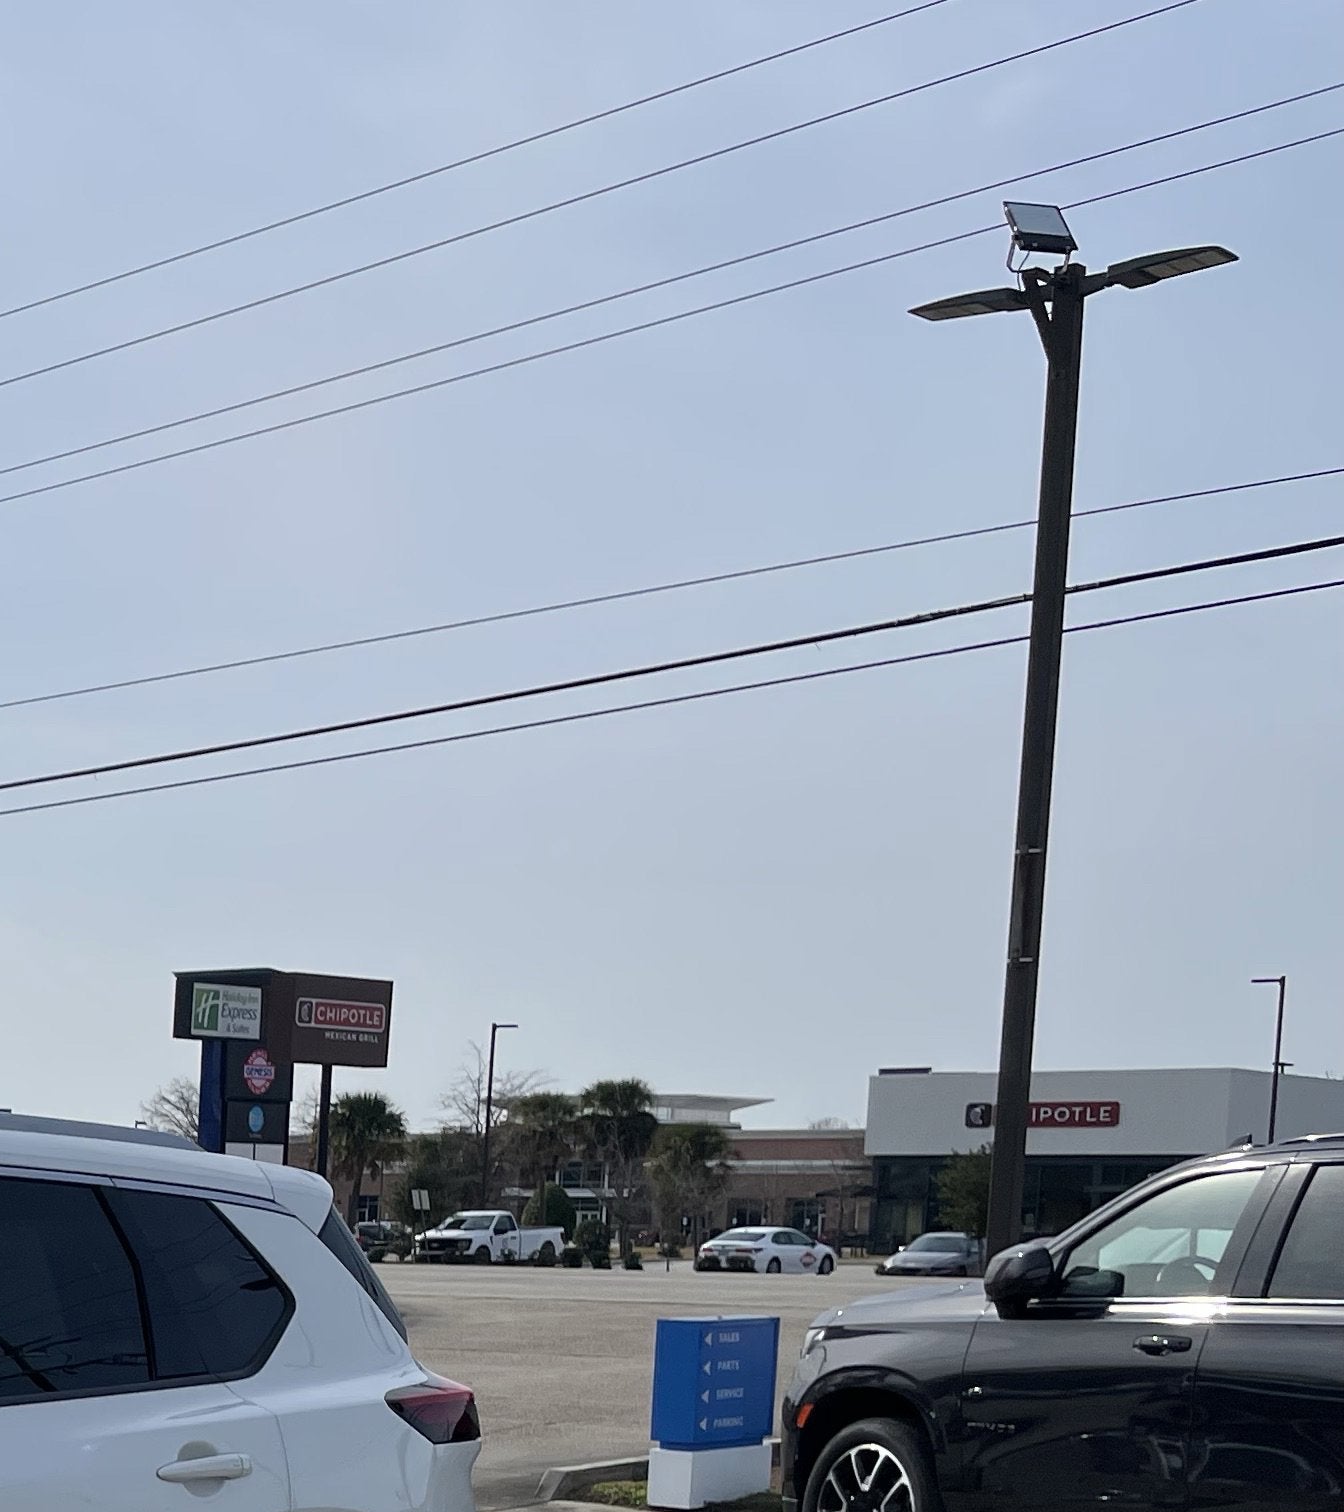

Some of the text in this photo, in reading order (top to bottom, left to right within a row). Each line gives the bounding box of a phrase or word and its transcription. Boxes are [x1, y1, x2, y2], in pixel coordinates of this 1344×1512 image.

[221, 1003, 258, 1022] Express
[316, 1006, 381, 1025] CHIPOTLE
[324, 1031, 379, 1043] MEXICAN GRILL
[1031, 1106, 1112, 1123] IPOTLE
[719, 1332, 740, 1343] SALES
[717, 1359, 740, 1371] PARTS
[716, 1387, 744, 1401] SERVICE
[714, 1416, 743, 1429] PARKING
